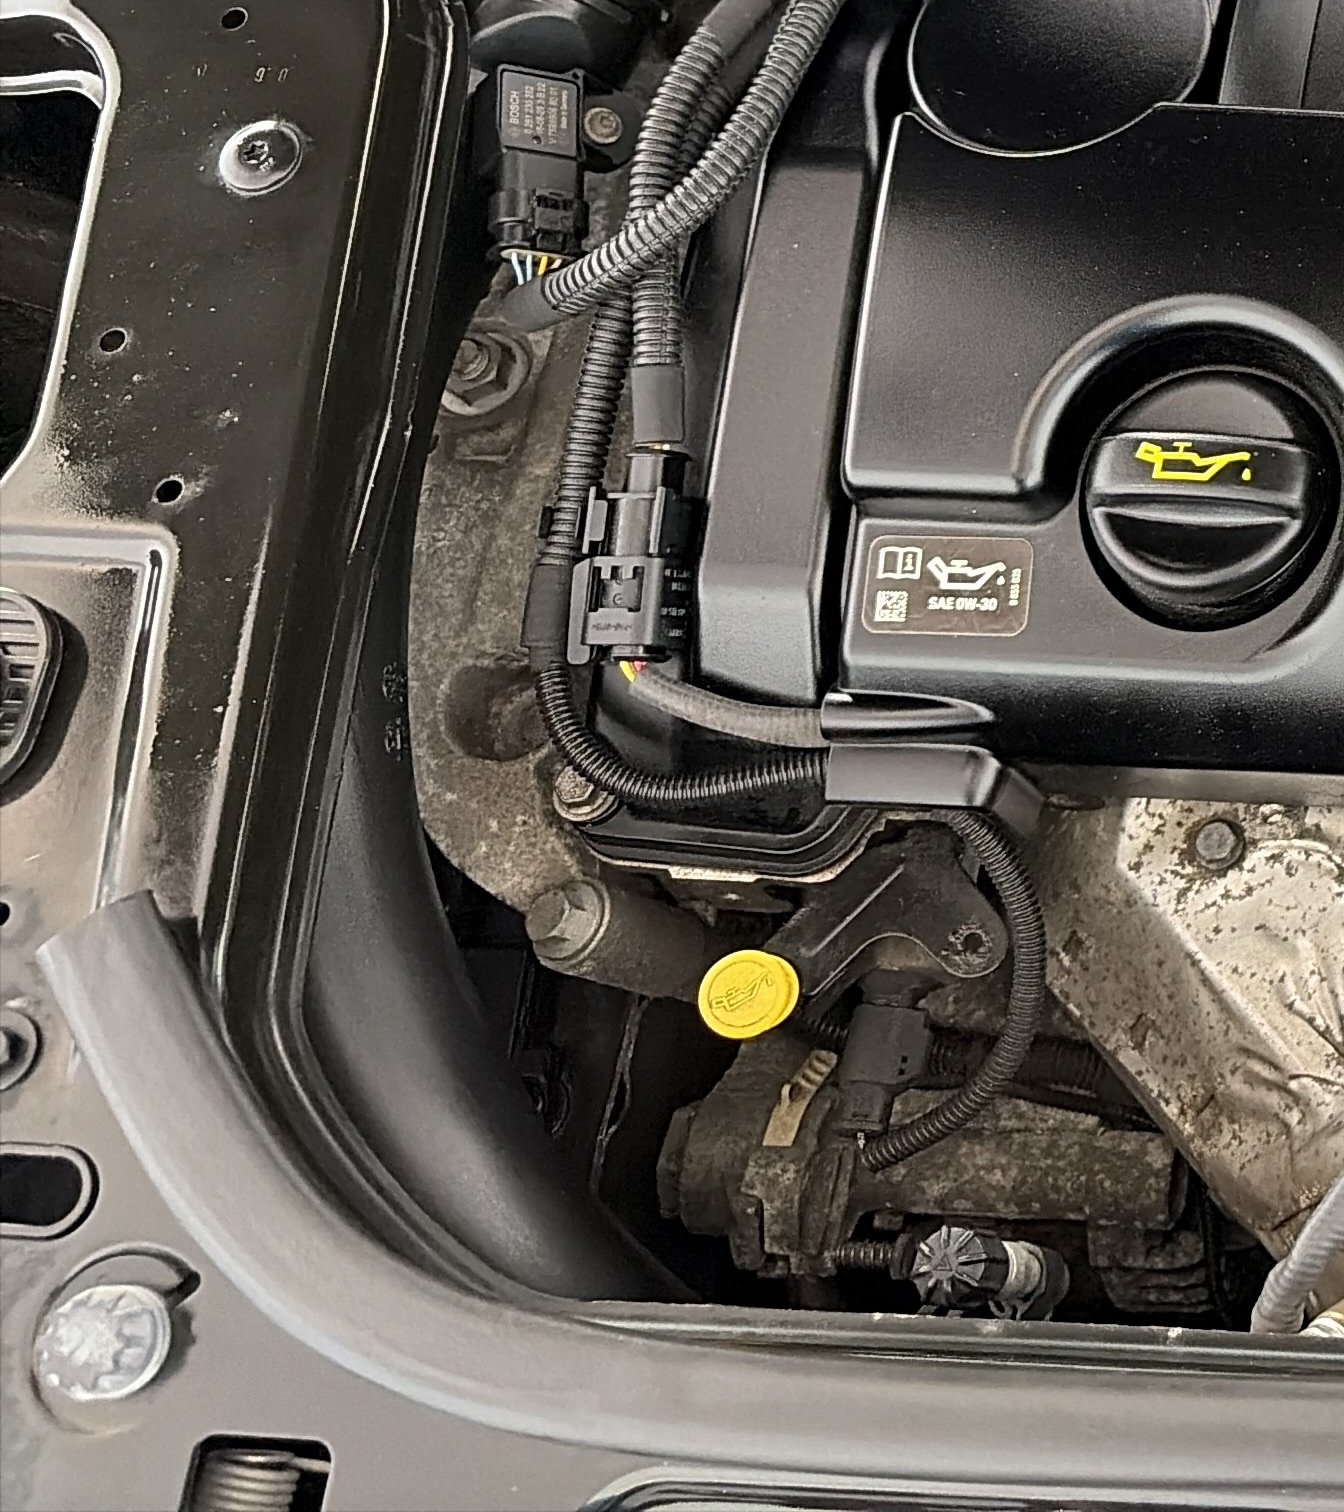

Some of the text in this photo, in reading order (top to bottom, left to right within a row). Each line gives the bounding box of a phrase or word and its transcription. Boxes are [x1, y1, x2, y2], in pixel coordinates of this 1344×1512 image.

[509, 90, 520, 125] BOSCH
[927, 596, 998, 611] SAE 0W-30
